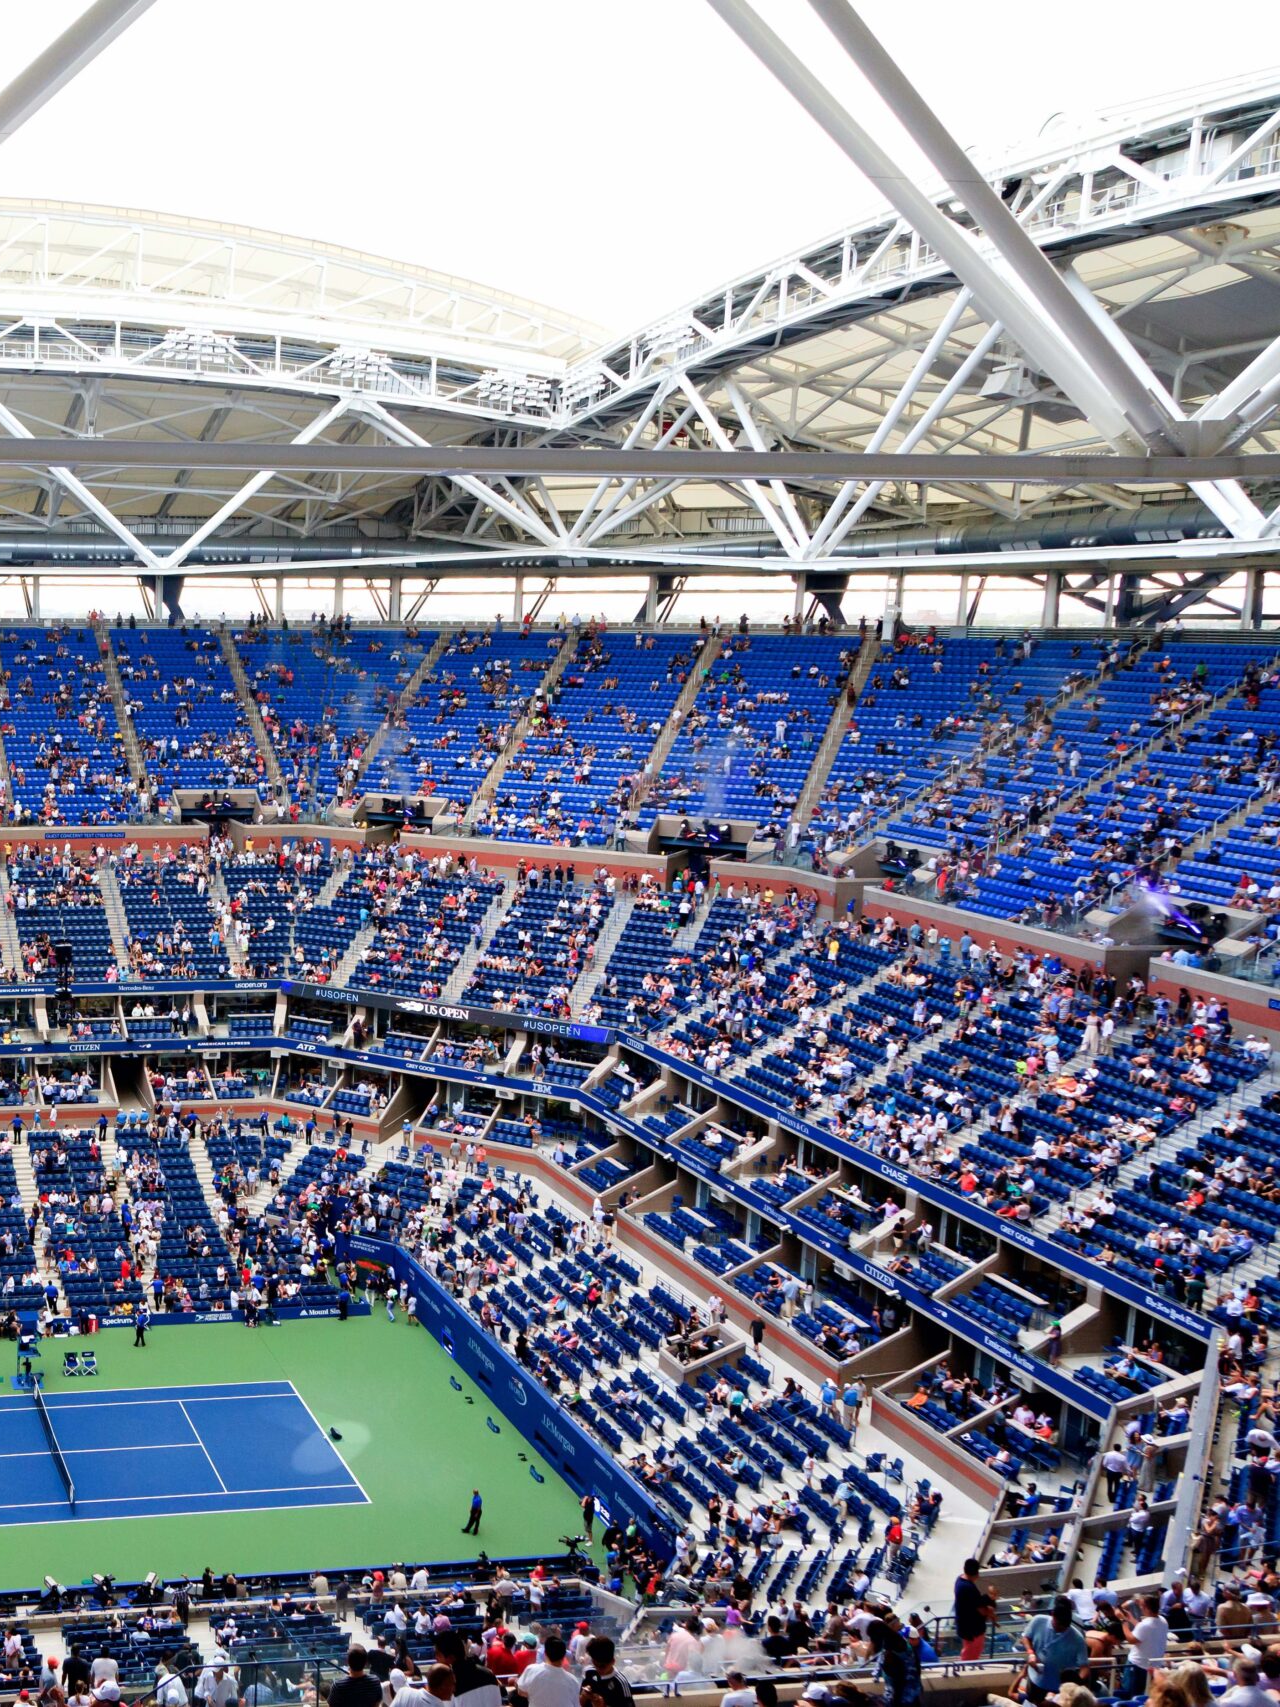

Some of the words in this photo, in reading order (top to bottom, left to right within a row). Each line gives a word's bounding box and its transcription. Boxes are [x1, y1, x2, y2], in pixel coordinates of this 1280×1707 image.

[118, 984, 154, 992] Mercedes-Benz
[234, 981, 268, 990] usopen.org
[315, 989, 359, 1003] #USOPEN
[424, 1003, 438, 1016] US
[439, 1006, 469, 1021] OPEN
[69, 1043, 101, 1052] CITIZEN
[296, 1042, 316, 1052] ATP
[532, 1083, 552, 1095] IBM
[880, 1163, 909, 1185] CHASE
[863, 1263, 896, 1289] CITIZEN
[308, 1308, 329, 1316] Mount
[102, 1318, 131, 1326] Spectrum
